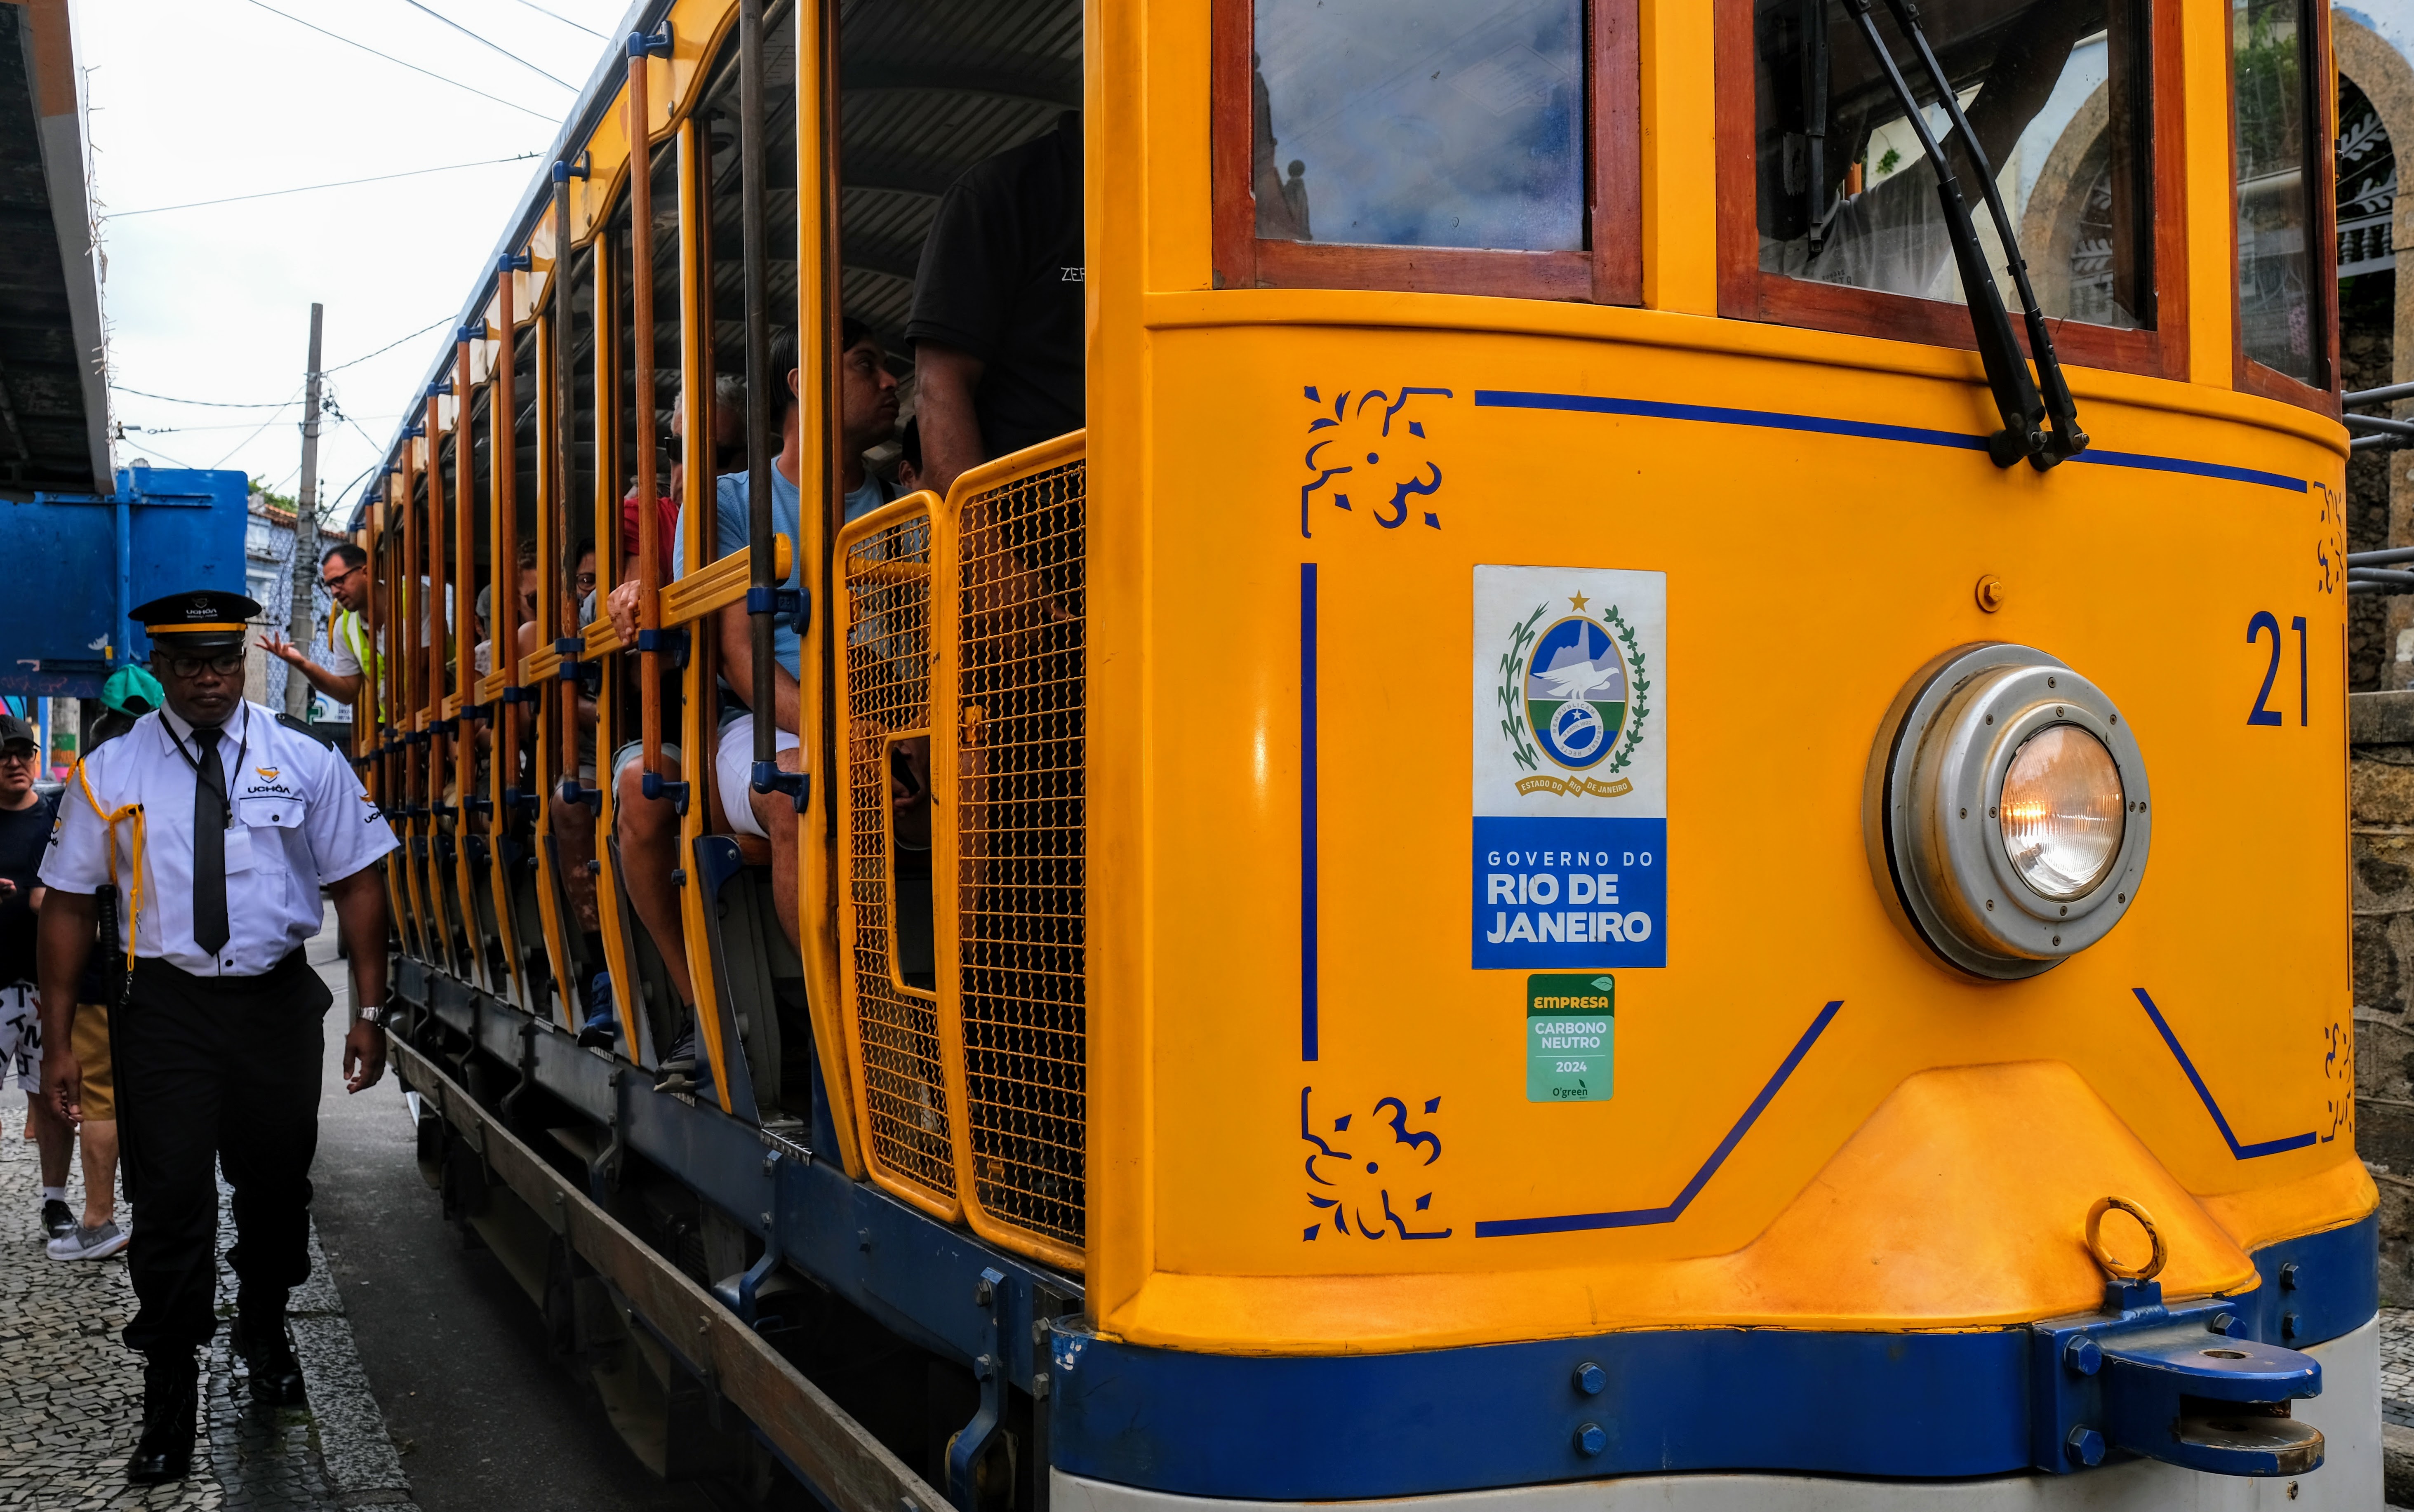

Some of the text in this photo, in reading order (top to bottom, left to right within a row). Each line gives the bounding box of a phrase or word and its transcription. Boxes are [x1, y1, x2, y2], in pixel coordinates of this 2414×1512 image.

[2246, 611, 2307, 727] 21
[1553, 703, 1602, 756] REMPUBLICAM GERERE RECTE
[1567, 724, 1581, 734] ABRIL
[1521, 780, 1628, 793] ESTADO DO RIO DE JANEIRO
[1488, 851, 1652, 866] GOVERNO DO
[1487, 873, 1619, 905] RIO DE
[1487, 911, 1652, 944] JANEIRO
[1534, 996, 1608, 1009] EMPRESA
[1535, 1022, 1607, 1035] CARBONO
[1542, 1036, 1600, 1049] NEUTRO
[1556, 1061, 1587, 1072] 2024
[1553, 1087, 1588, 1098] O'green
